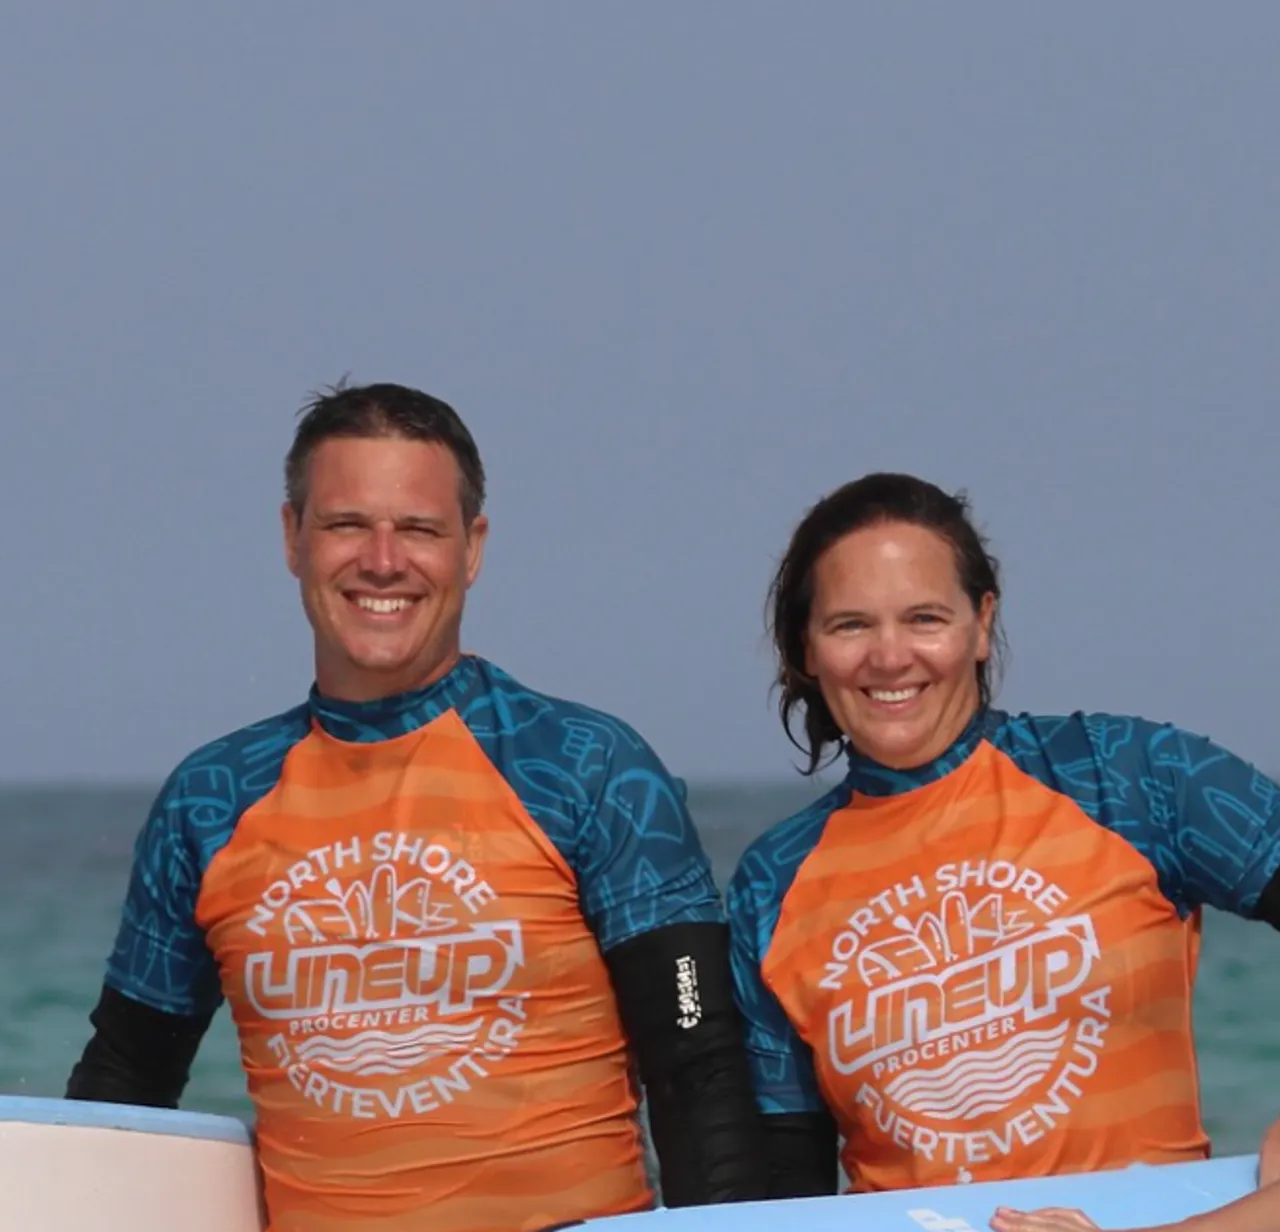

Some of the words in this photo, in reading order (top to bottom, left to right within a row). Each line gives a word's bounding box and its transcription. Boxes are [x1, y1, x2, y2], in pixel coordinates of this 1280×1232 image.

[246, 836, 361, 937] NORTH
[373, 831, 499, 915] SHORE
[819, 875, 926, 991] NORTH
[935, 860, 1069, 915] SHORE
[288, 1006, 430, 1036] PROCENTER
[855, 985, 1112, 1163] FUERTEVENTURA
[872, 1017, 1018, 1079] PROCENTER
